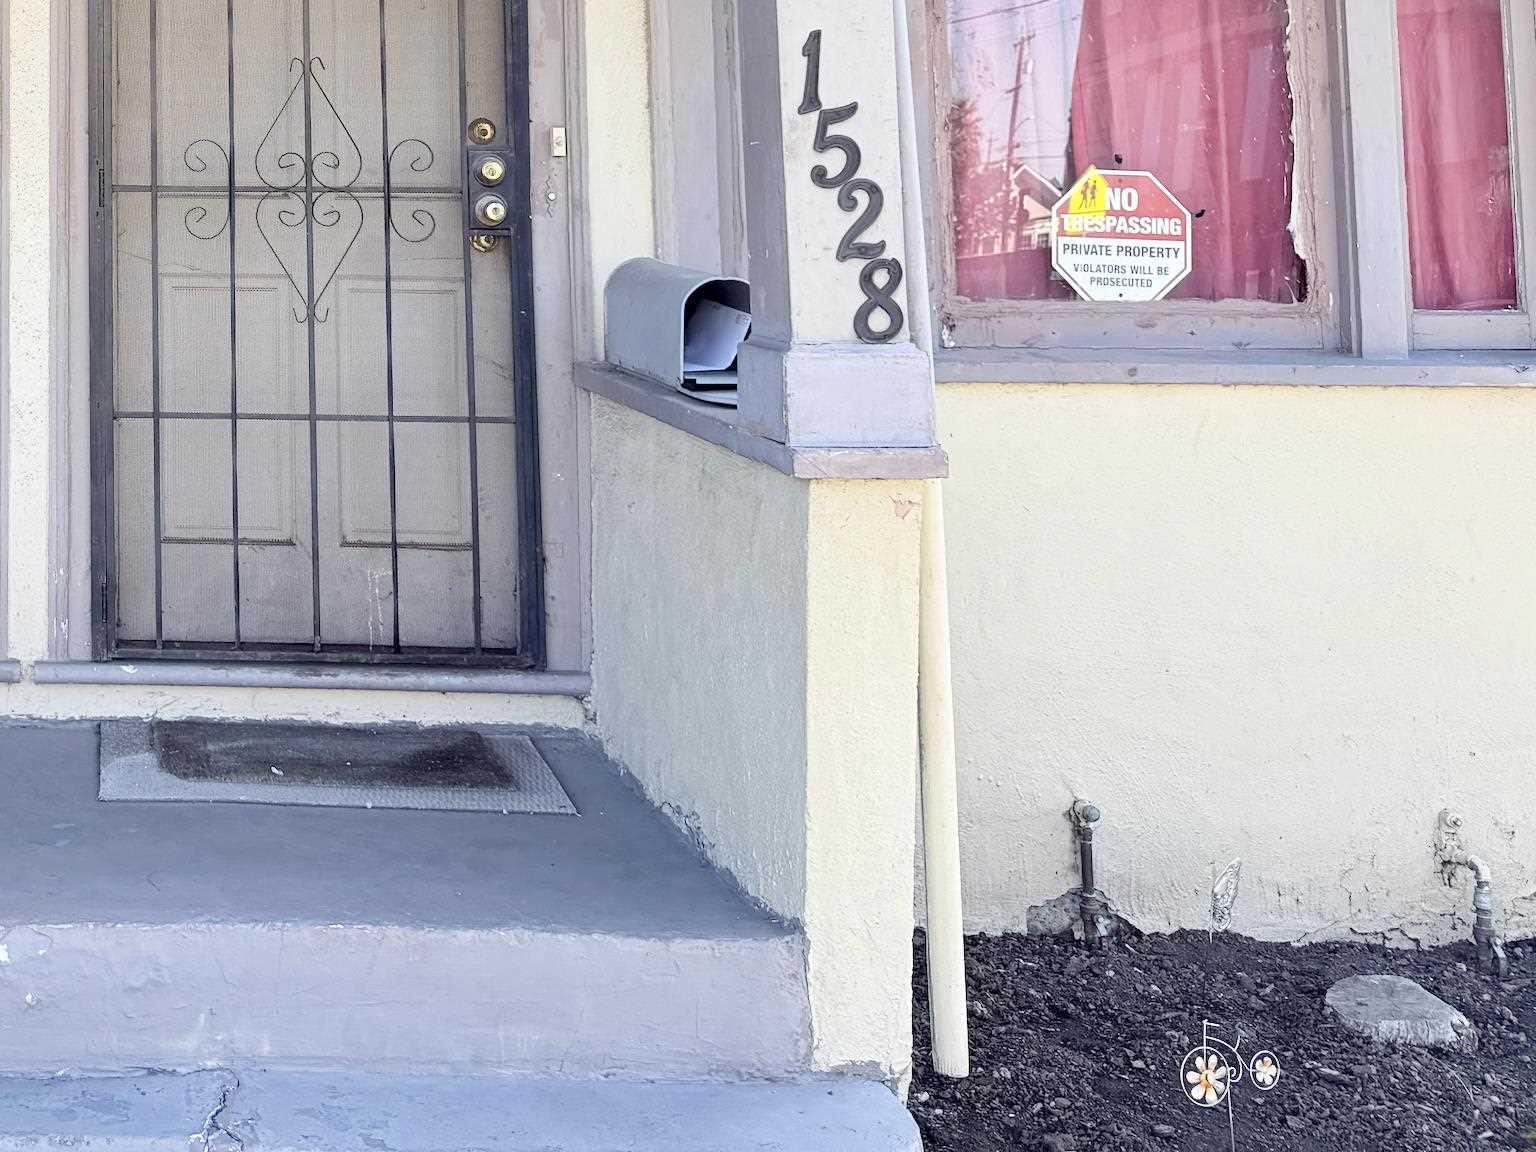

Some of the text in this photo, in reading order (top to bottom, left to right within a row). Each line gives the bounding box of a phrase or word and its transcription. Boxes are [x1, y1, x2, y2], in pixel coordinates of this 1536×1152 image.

[797, 29, 904, 344] 1528
[1105, 187, 1139, 212] NO
[1063, 243, 1180, 259] PRIVATE PROPERTY
[1073, 263, 1169, 276] VIOLATORS WILL BE
[1089, 276, 1153, 288] PROSECUTED
